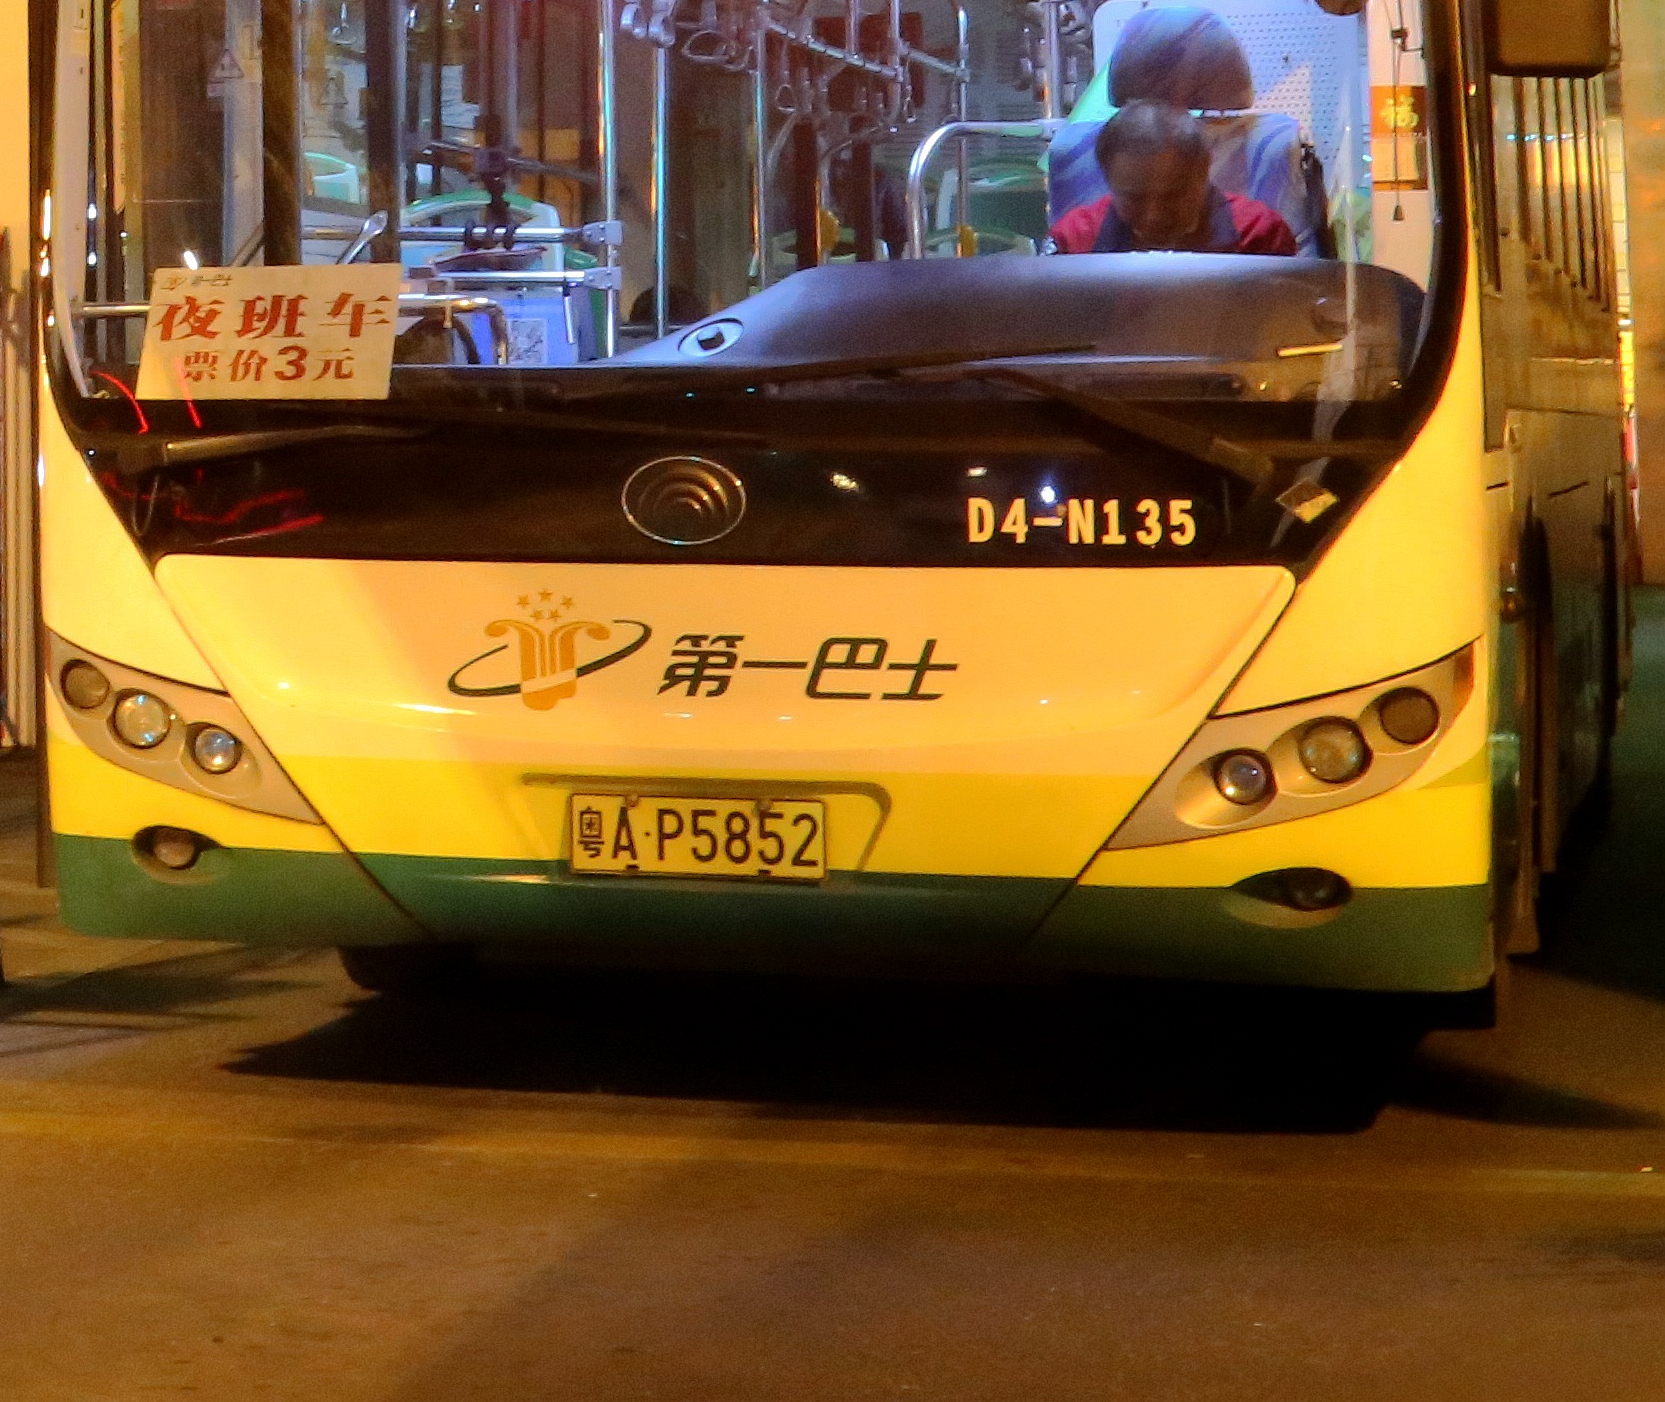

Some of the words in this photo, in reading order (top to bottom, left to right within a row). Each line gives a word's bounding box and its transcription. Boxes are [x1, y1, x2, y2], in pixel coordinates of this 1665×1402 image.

[152, 292, 392, 342] 夜班车
[183, 345, 355, 382] 票价3元
[967, 496, 1197, 546] D4-N135
[657, 634, 960, 701] 第一巴士
